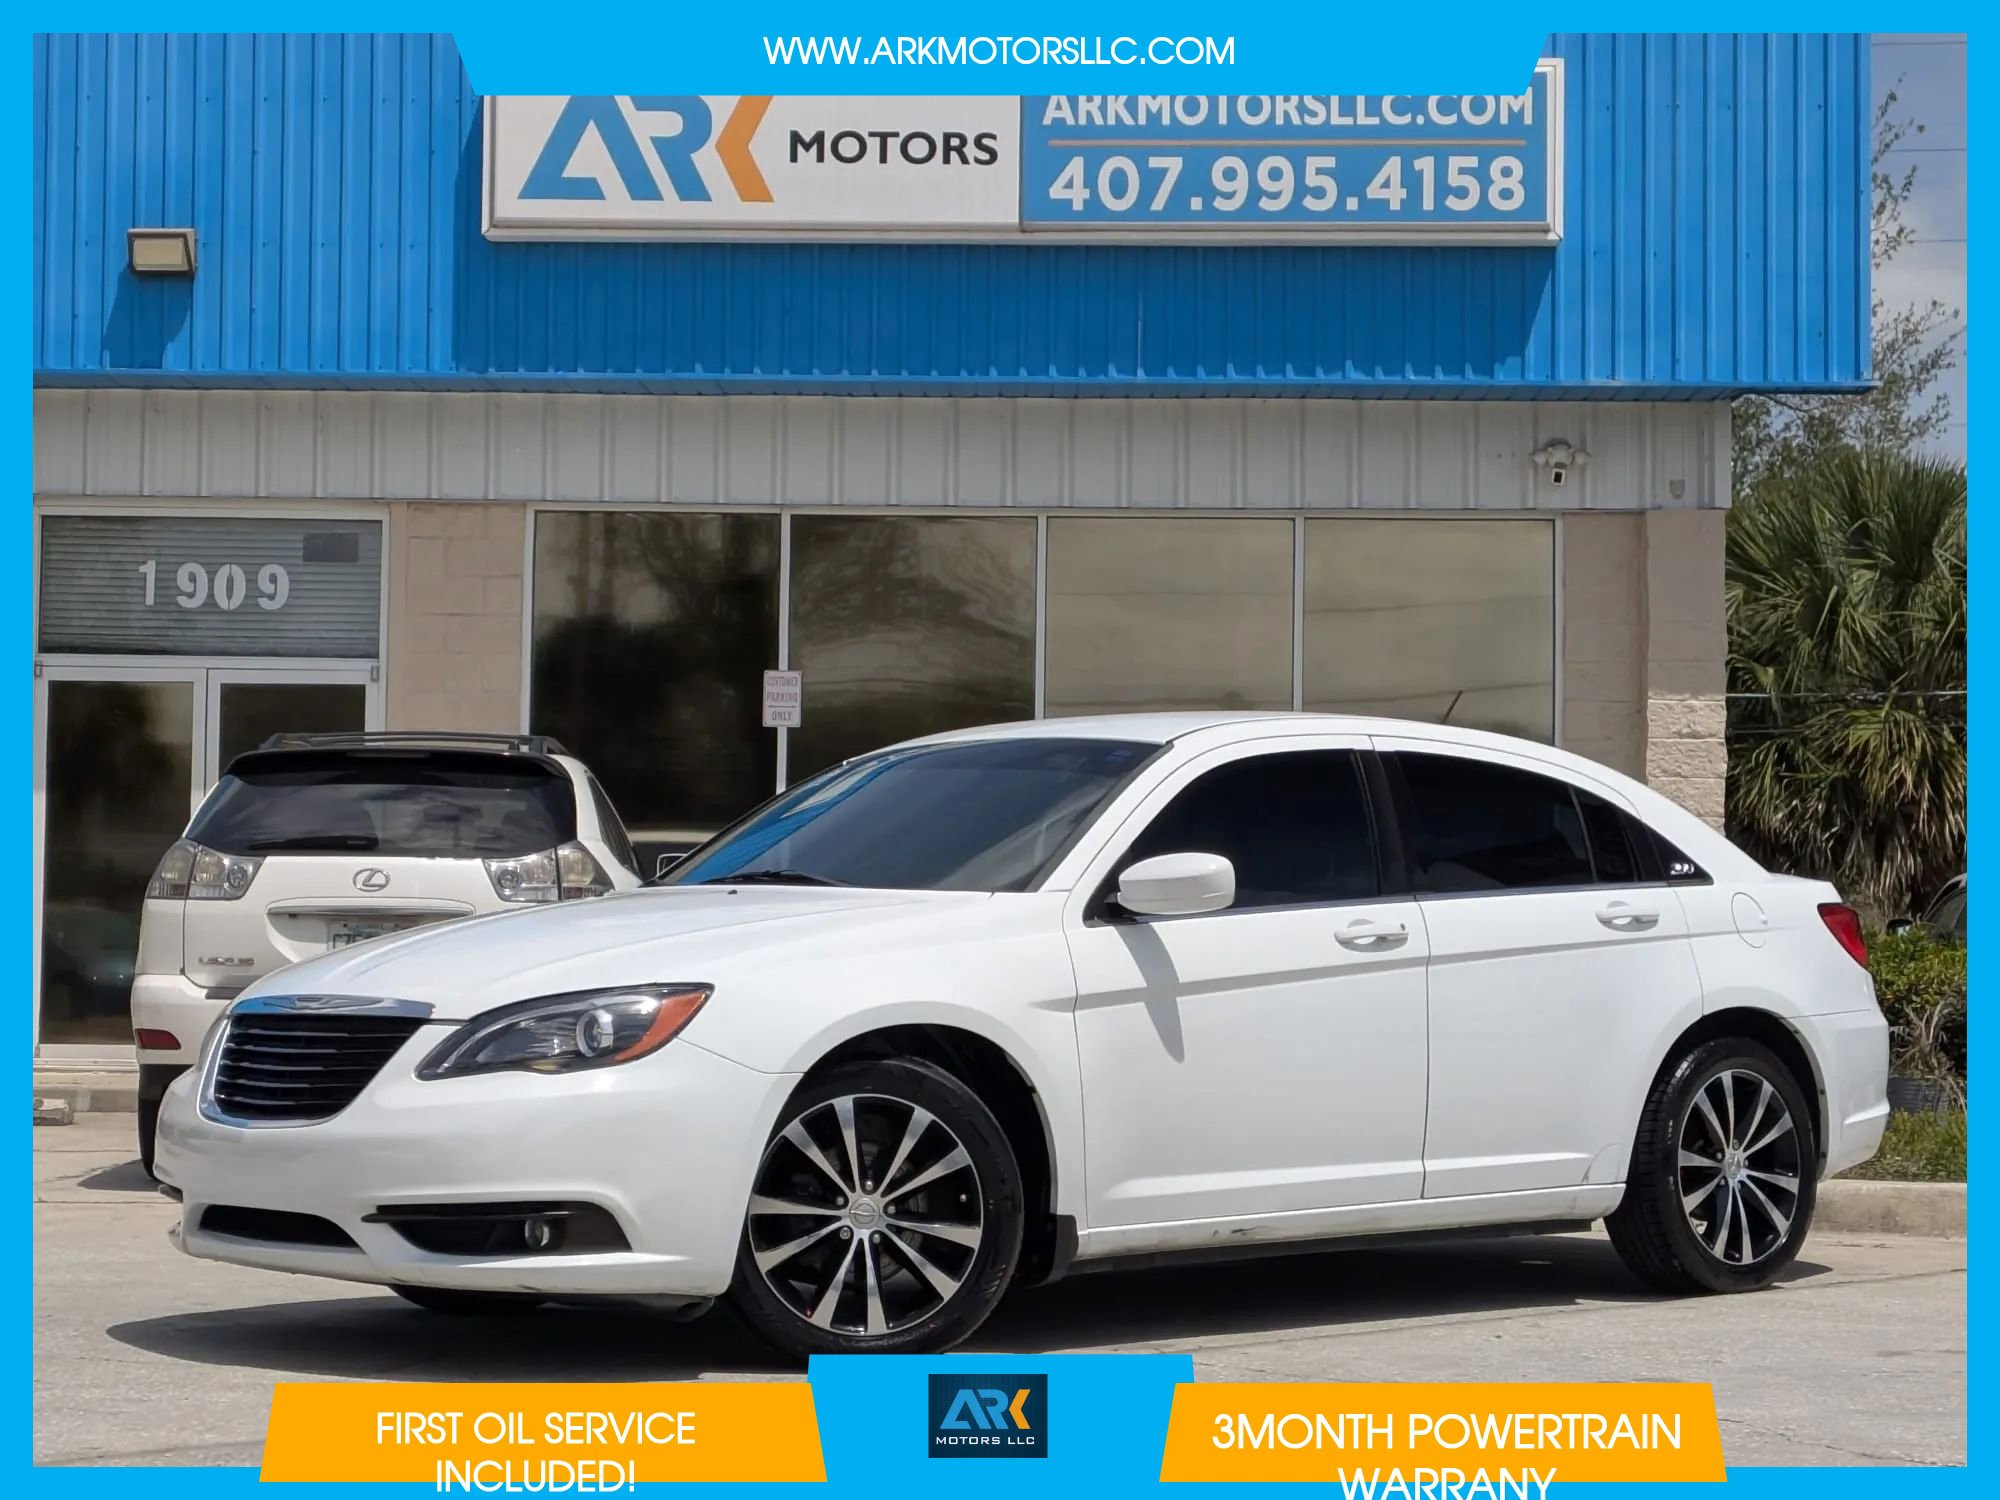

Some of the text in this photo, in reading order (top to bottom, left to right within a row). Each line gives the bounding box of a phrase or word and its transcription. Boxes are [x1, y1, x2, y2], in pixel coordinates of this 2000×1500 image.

[1042, 88, 1533, 127] ARKMOTORSLLC.COM
[517, 95, 999, 204] ARK MOTORS
[1048, 155, 1526, 212] 407.995.4158
[138, 559, 291, 611] 1909
[771, 710, 792, 721] ONLY
